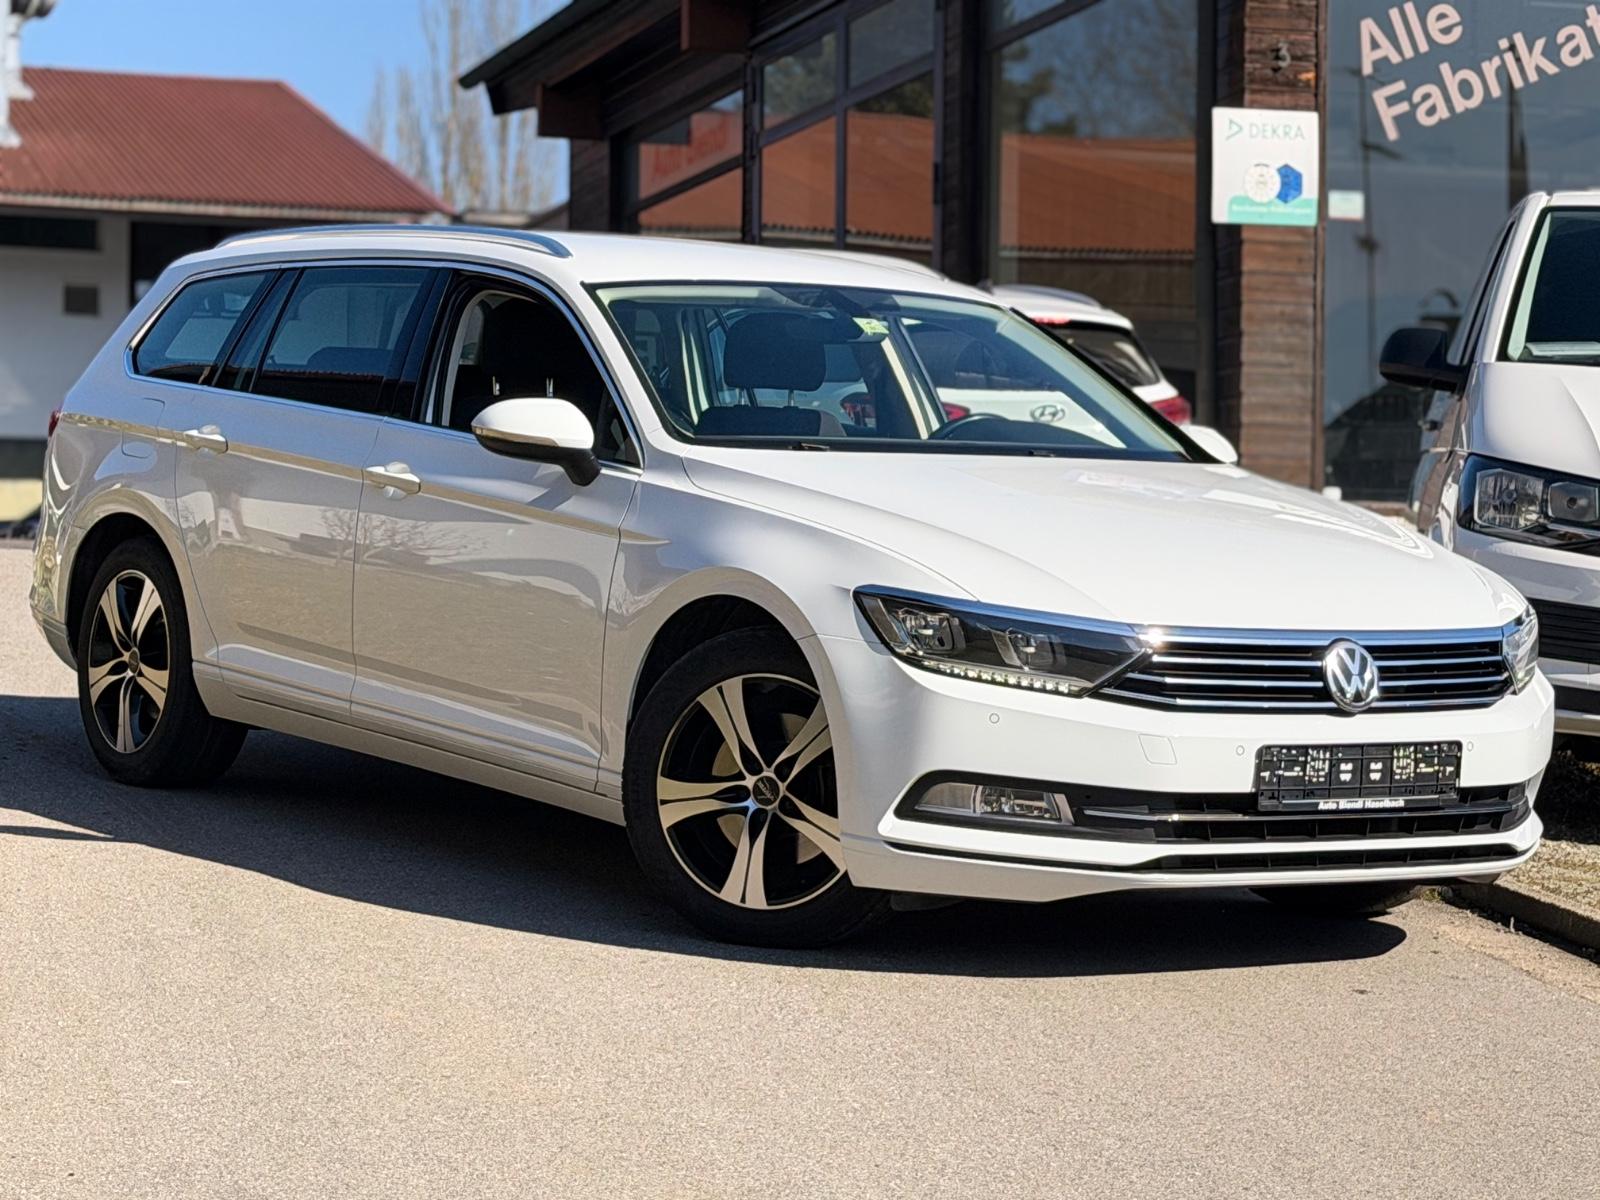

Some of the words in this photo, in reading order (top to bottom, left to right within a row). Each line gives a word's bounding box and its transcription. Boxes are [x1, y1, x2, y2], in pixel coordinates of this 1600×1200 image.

[1360, 1, 1464, 77] Alle
[1249, 123, 1305, 141] DEKRA
[1318, 801, 1337, 810] Auto
